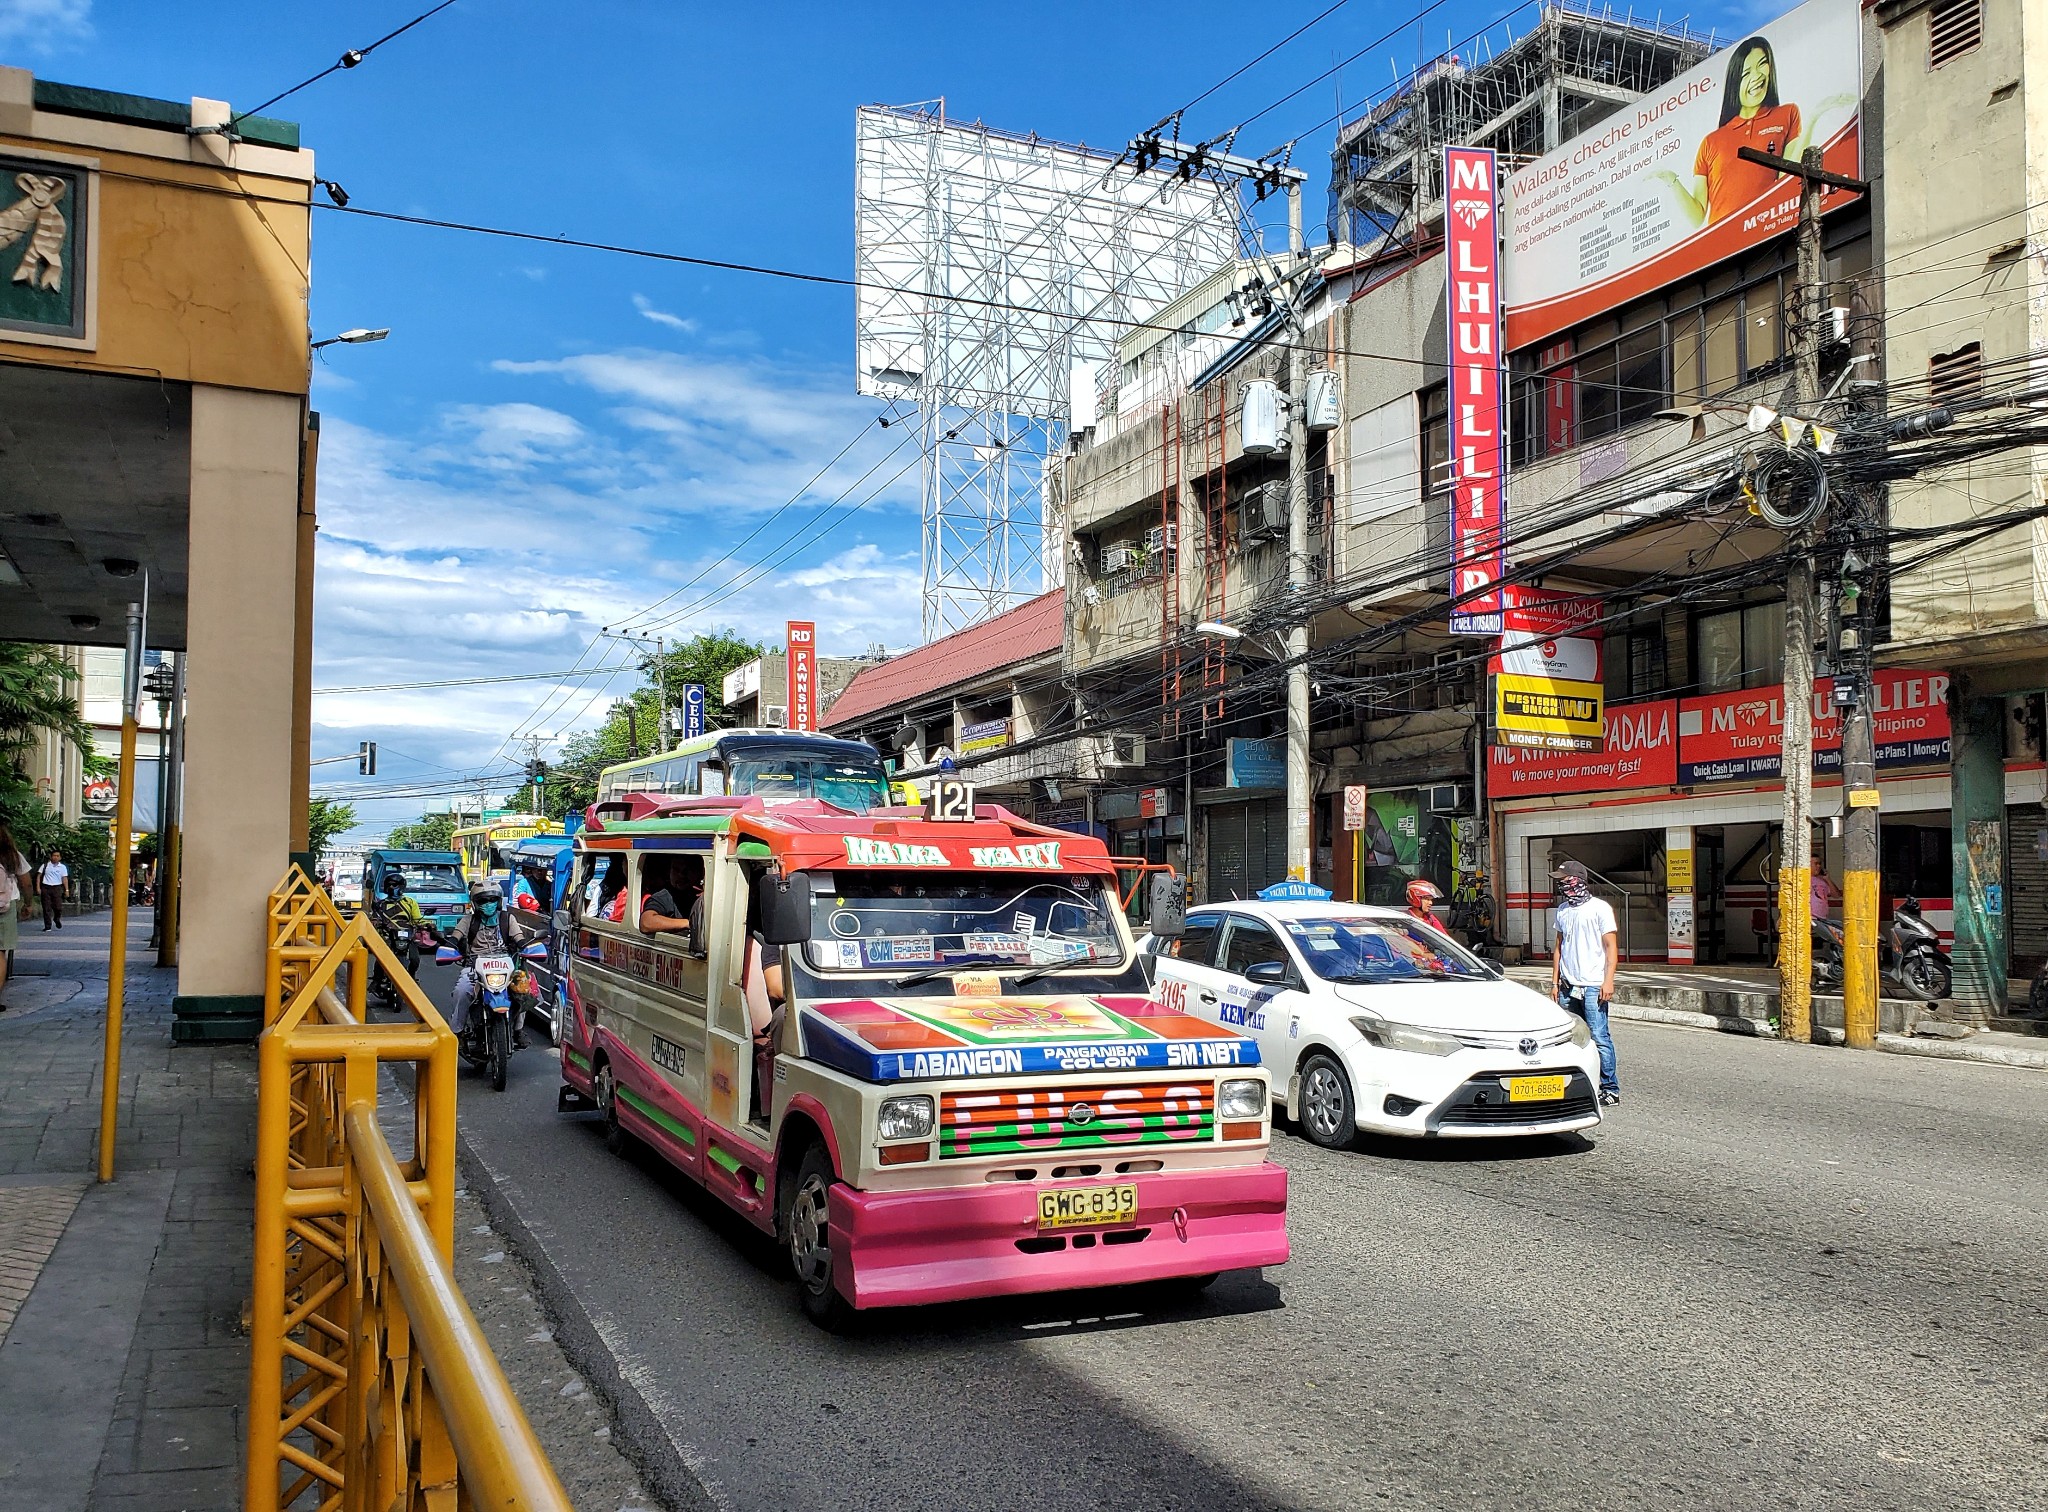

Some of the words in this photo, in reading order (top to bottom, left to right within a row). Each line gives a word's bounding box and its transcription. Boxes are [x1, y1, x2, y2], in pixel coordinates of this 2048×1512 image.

[1512, 155, 1569, 199] Walang
[1573, 122, 1632, 165] cheche
[1637, 76, 1717, 131] bureche.
[1514, 205, 1530, 219] Ang
[1531, 184, 1560, 209] dali-dali
[1560, 179, 1572, 194] ng
[1572, 169, 1597, 189] forms.
[1598, 158, 1616, 173] Ang
[1617, 141, 1640, 161] liit-liit
[1641, 136, 1654, 149] ng
[1654, 124, 1676, 142] fees.
[1514, 221, 1530, 237] Ang
[1531, 199, 1570, 227] dali-daling
[1570, 178, 1610, 209] puntahan.
[1610, 164, 1632, 185] Dahil
[1633, 154, 1654, 172] over
[1655, 138, 1681, 161] 1,850
[1602, 204, 1622, 220] Services
[1622, 198, 1635, 211] Offer
[1514, 239, 1529, 253] ang
[1529, 223, 1562, 247] branches
[1562, 199, 1609, 232] nationwide.
[1763, 221, 1776, 232] Ang
[1776, 213, 1794, 226] Tulay
[1504, 593, 1515, 609] ML
[1519, 594, 1559, 616] KWARTA
[1562, 601, 1598, 619] PADALA
[1472, 616, 1501, 632] ROSARIO
[791, 630, 811, 642] RD
[797, 652, 808, 732] PAWNSHOP
[1505, 693, 1558, 707] WESTERN
[1522, 704, 1558, 716] UNION
[1563, 699, 1592, 719] WU
[1509, 733, 1545, 745] MONEY
[1546, 737, 1593, 750] CHANGER
[1731, 735, 1765, 749] Tulay
[1885, 745, 1906, 759] Plans
[1914, 742, 1941, 757] Money
[1512, 770, 1526, 782] We
[1528, 769, 1554, 781] move
[1555, 768, 1579, 782] your
[1581, 764, 1614, 778] money
[1617, 757, 1643, 773] fast!
[1693, 765, 1711, 778] Quick
[1712, 763, 1728, 776] Cash
[1728, 761, 1745, 774] Loan
[1751, 757, 1781, 772] KWARTA
[495, 829, 511, 838] FREE
[511, 829, 537, 838] SHUTTLE
[843, 836, 951, 867] MAMA
[968, 841, 1064, 869] MARY
[1269, 887, 1288, 897] VACANT
[1288, 883, 1306, 896] TAXI
[870, 939, 893, 961] SM
[969, 942, 988, 951] PIER
[483, 960, 509, 970] MEDIA
[1158, 979, 1188, 1013] 3195
[1219, 1002, 1247, 1027] KEN
[1247, 1011, 1266, 1031] TAXI
[1044, 1044, 1148, 1060] PANGANIBAN
[898, 1049, 1023, 1078] LABANGON
[1060, 1056, 1137, 1069] COLON
[953, 1087, 1203, 1153] FUSO
[1057, 1215, 1098, 1225] PHILIPPINES
